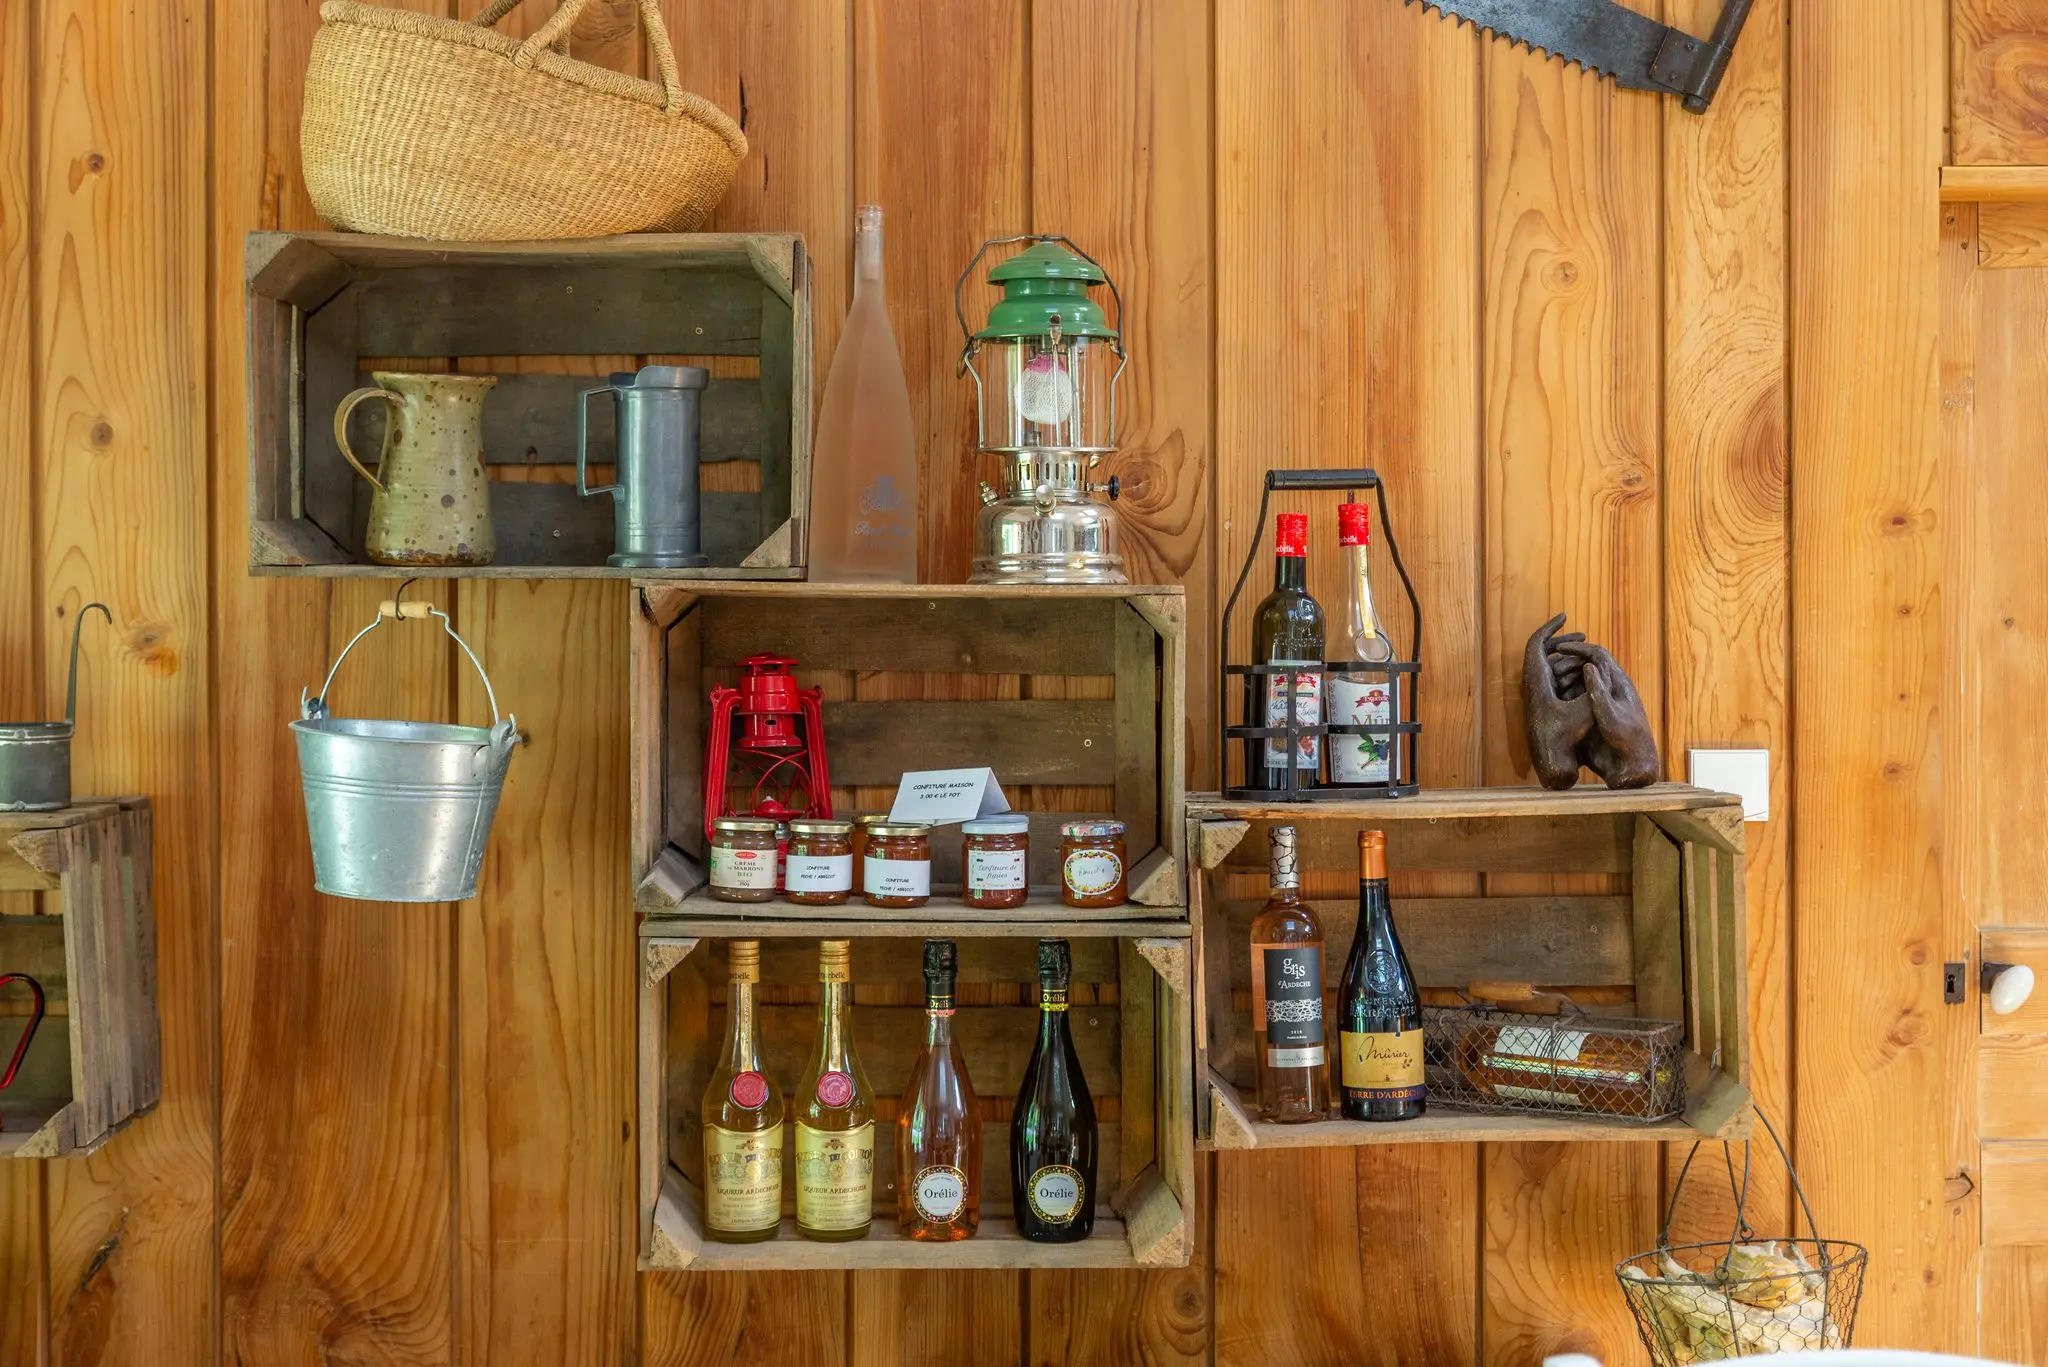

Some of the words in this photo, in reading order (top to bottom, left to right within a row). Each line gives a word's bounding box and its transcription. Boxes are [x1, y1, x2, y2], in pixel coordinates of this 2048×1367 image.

[912, 783, 948, 791] CONFITURE
[1283, 958, 1306, 980] gris
[1349, 1090, 1376, 1099] TERRE
[717, 1187, 744, 1196] LIQUEUR
[803, 1185, 828, 1194] LIQUEUR
[924, 1188, 958, 1199] Orélie
[1040, 1188, 1074, 1199] Orélie
